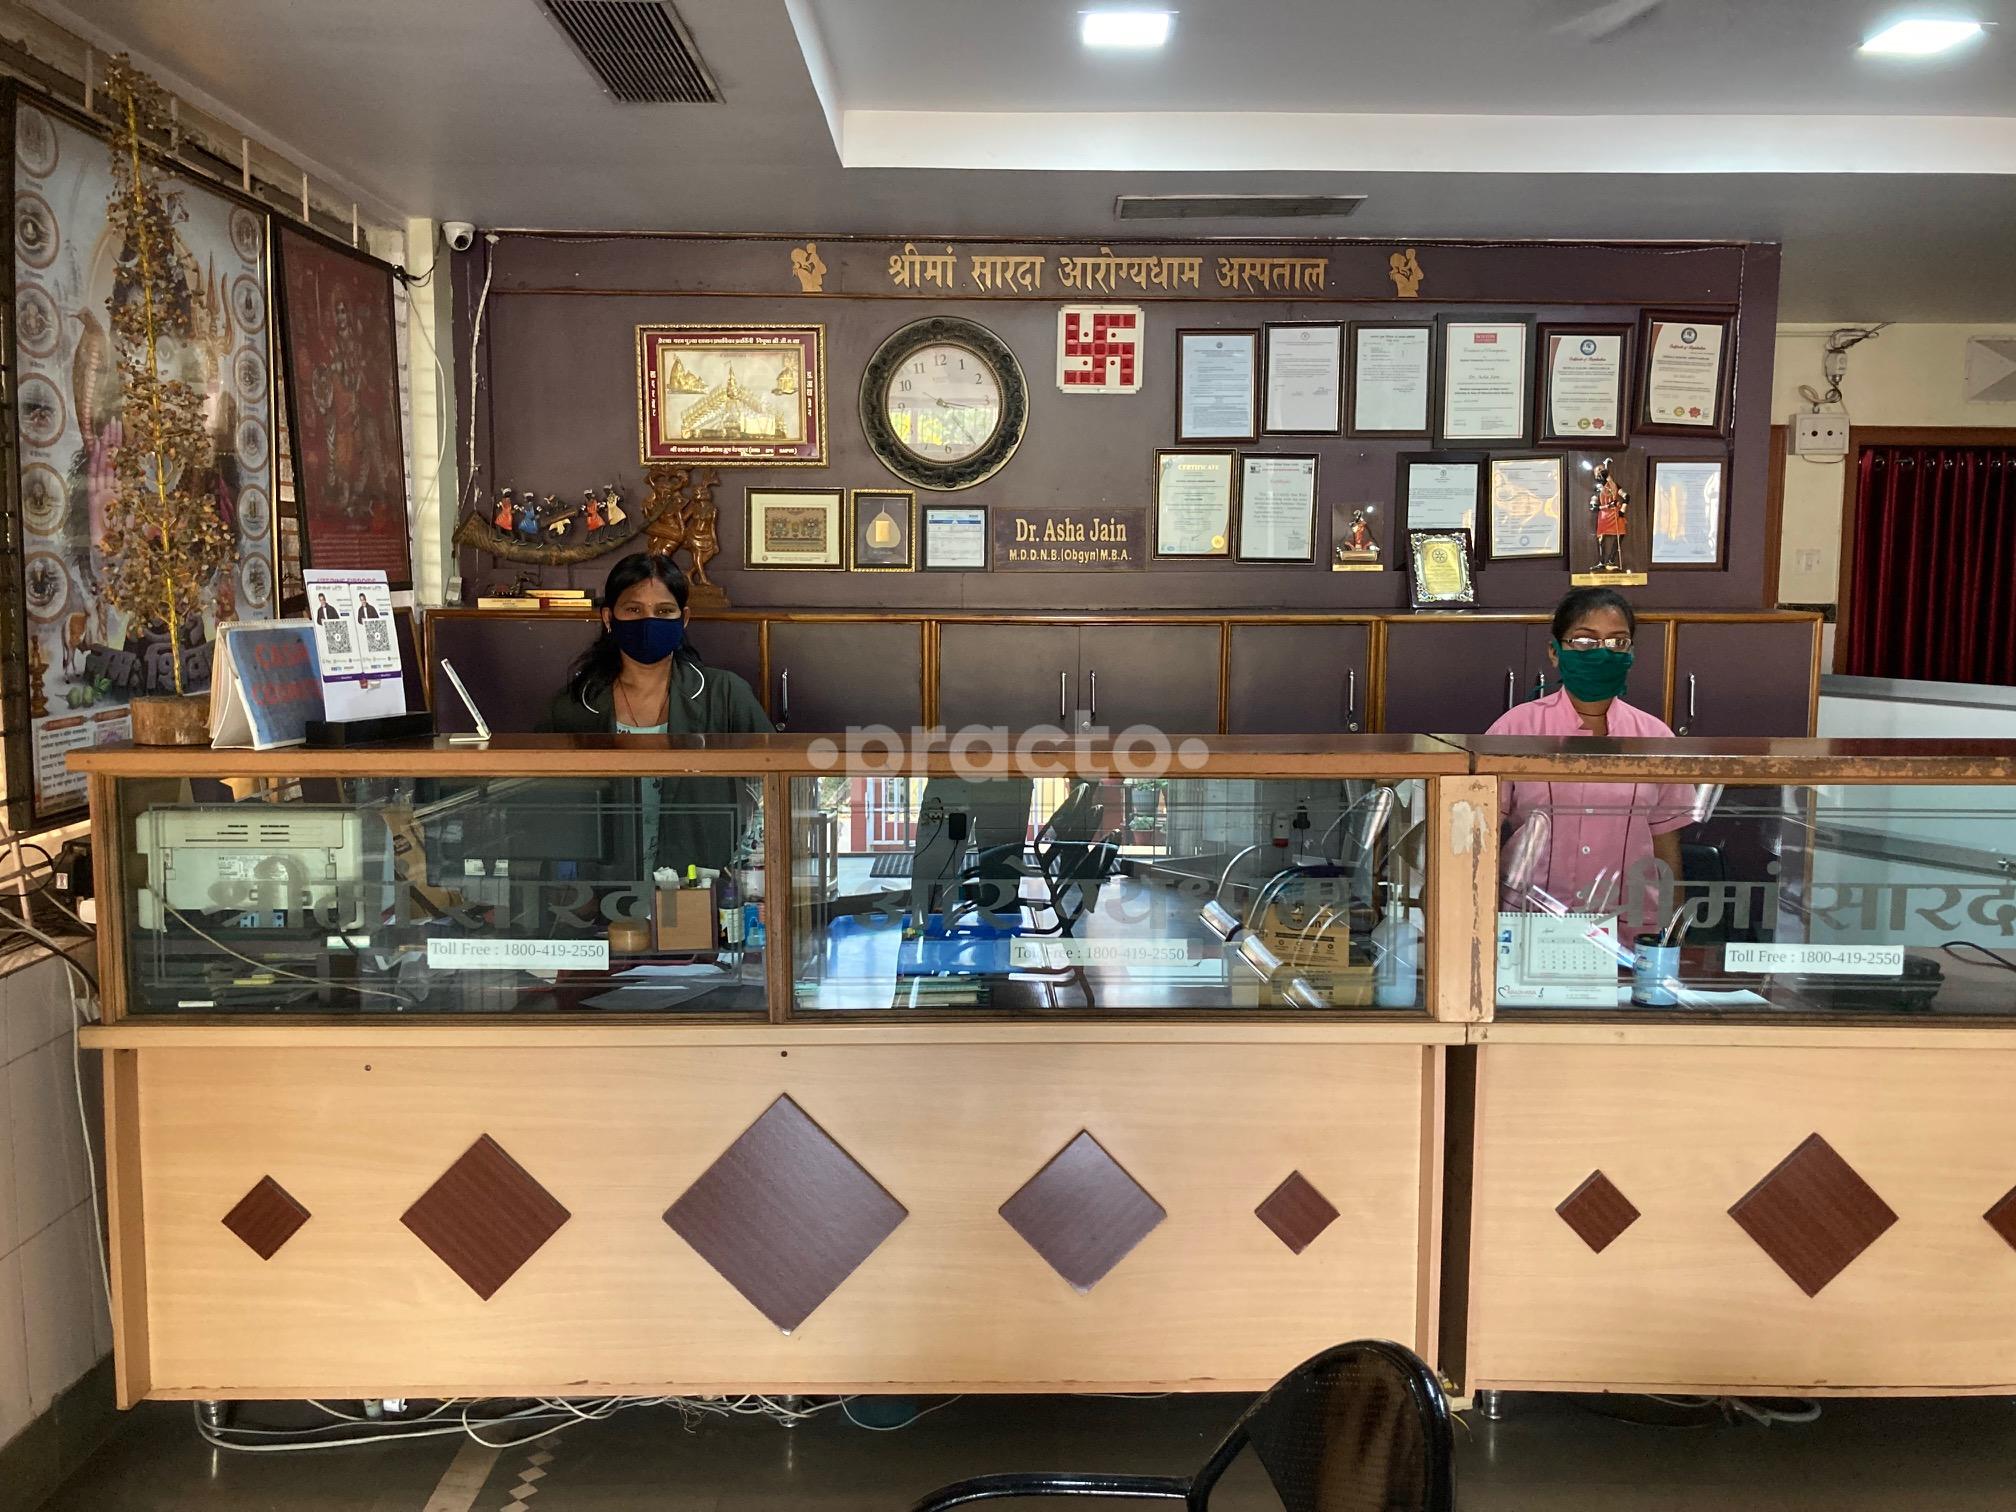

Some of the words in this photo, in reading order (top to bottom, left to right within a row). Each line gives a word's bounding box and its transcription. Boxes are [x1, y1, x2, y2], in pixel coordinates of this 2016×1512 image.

[889, 242, 957, 289] श्रीमां
[971, 256, 1045, 293] सारदा
[1058, 247, 1203, 294] आरोग्यधाम
[1215, 257, 1329, 294] अस्पताल
[934, 354, 947, 366] 12
[960, 359, 965, 370] 1
[914, 363, 925, 374] 11
[975, 373, 983, 384] 2
[900, 380, 911, 391] 10
[945, 446, 952, 455] 6
[1015, 518, 1039, 542] Dr.
[1043, 517, 1085, 542] Asha
[1089, 518, 1127, 542] Jain
[1808, 883, 2016, 936] सारद
[431, 942, 457, 955] Toll
[462, 943, 490, 956] Free
[504, 943, 604, 957] 1800-419-2550
[1087, 947, 1185, 960] 1800-419-2550
[1729, 950, 1754, 962] Toll
[1759, 951, 1787, 963] Free
[1801, 951, 1901, 965] 1800-419-2550
